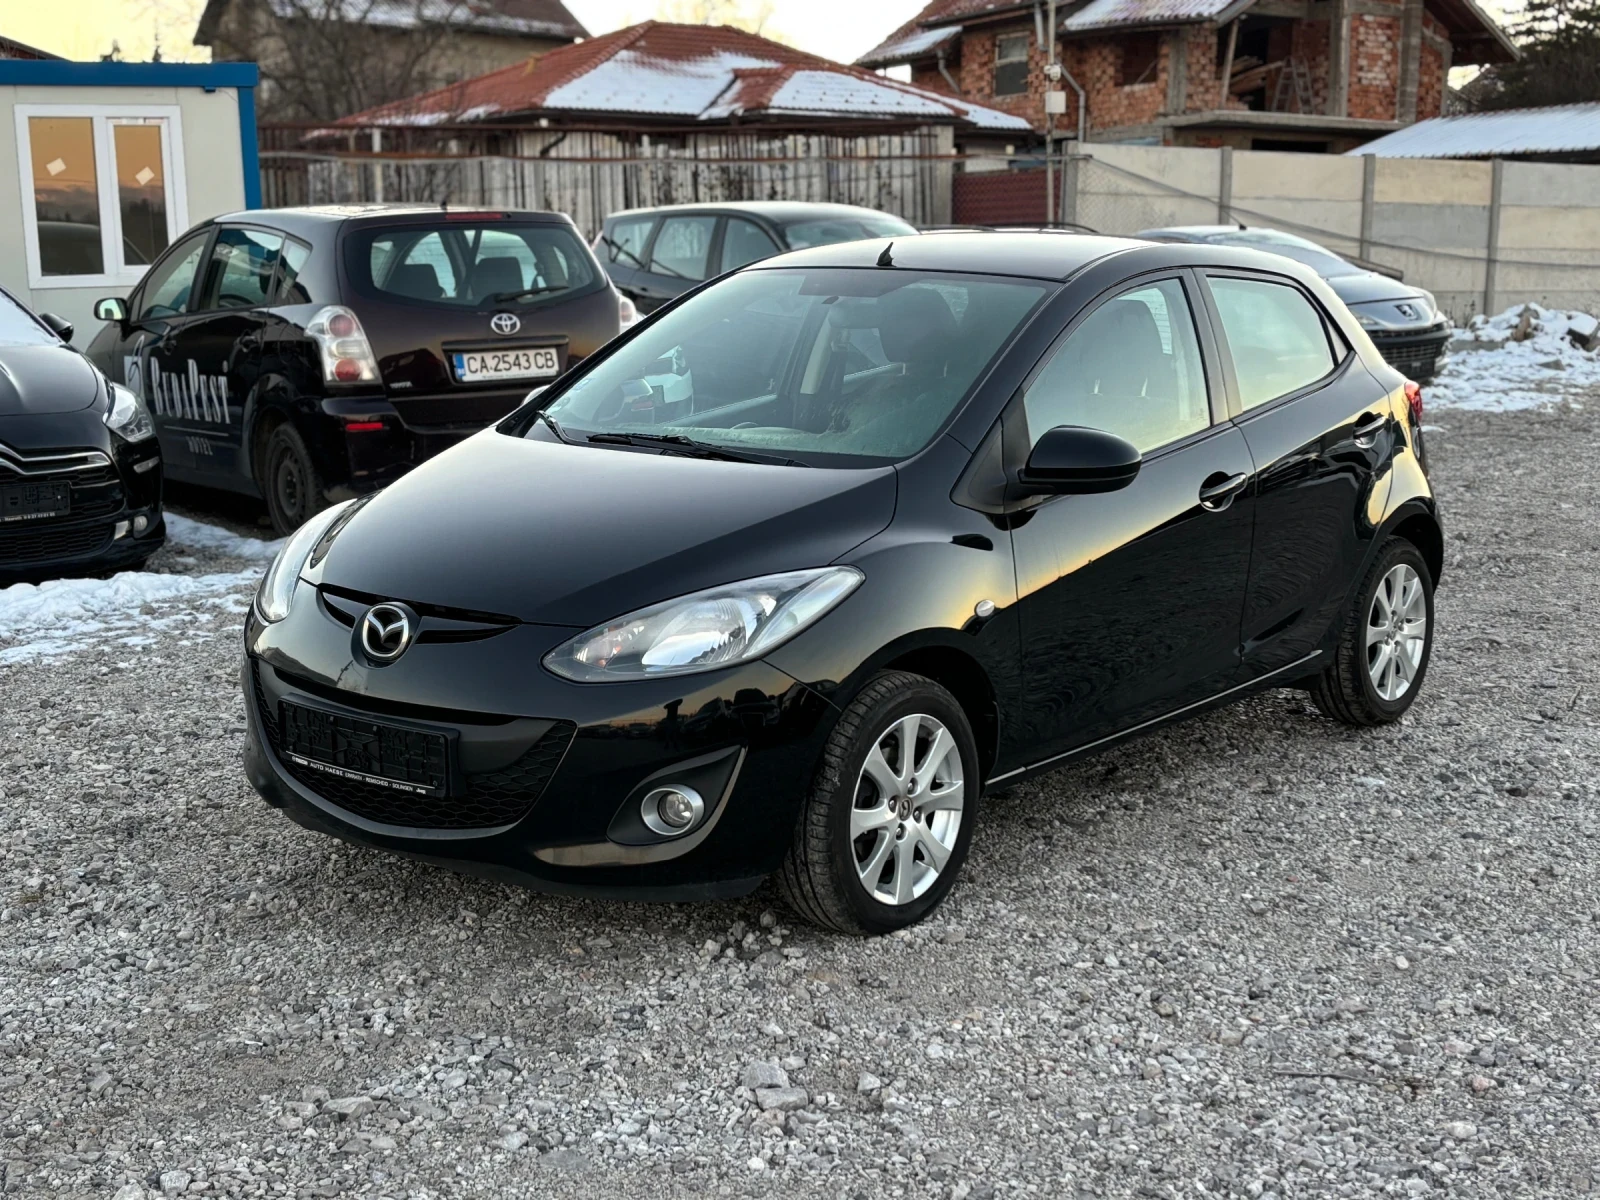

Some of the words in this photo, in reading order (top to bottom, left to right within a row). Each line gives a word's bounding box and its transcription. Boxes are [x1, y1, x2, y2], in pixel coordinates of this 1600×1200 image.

[466, 356, 490, 374] CA
[492, 353, 532, 372] 2543
[534, 351, 556, 370] CB
[310, 762, 324, 771] AUTO
